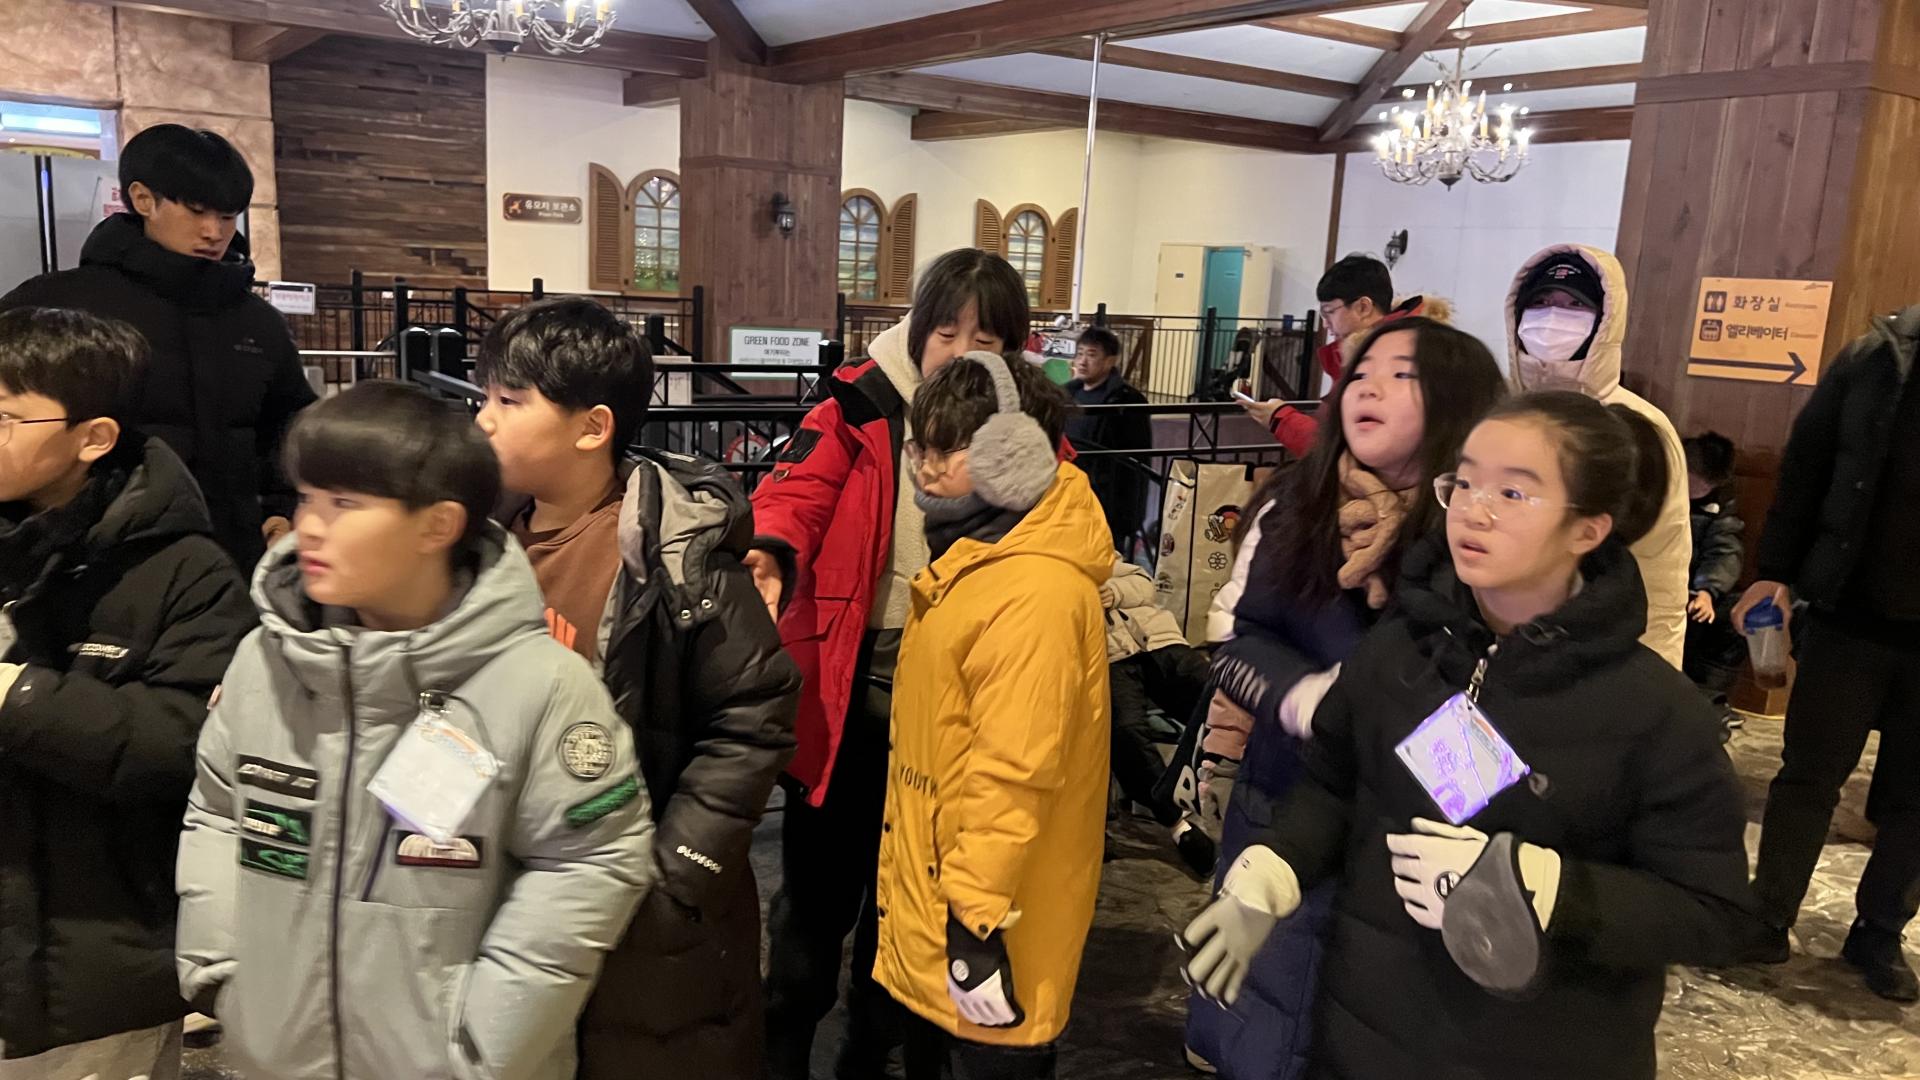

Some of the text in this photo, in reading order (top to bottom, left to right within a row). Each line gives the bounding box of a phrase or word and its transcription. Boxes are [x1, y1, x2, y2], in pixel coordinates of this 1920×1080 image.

[525, 199, 577, 213] 유모차 보관소
[1733, 294, 1782, 312] 화장실
[1726, 324, 1788, 341] 엘리베이터
[743, 335, 811, 347] GREEN FOOD ZONE
